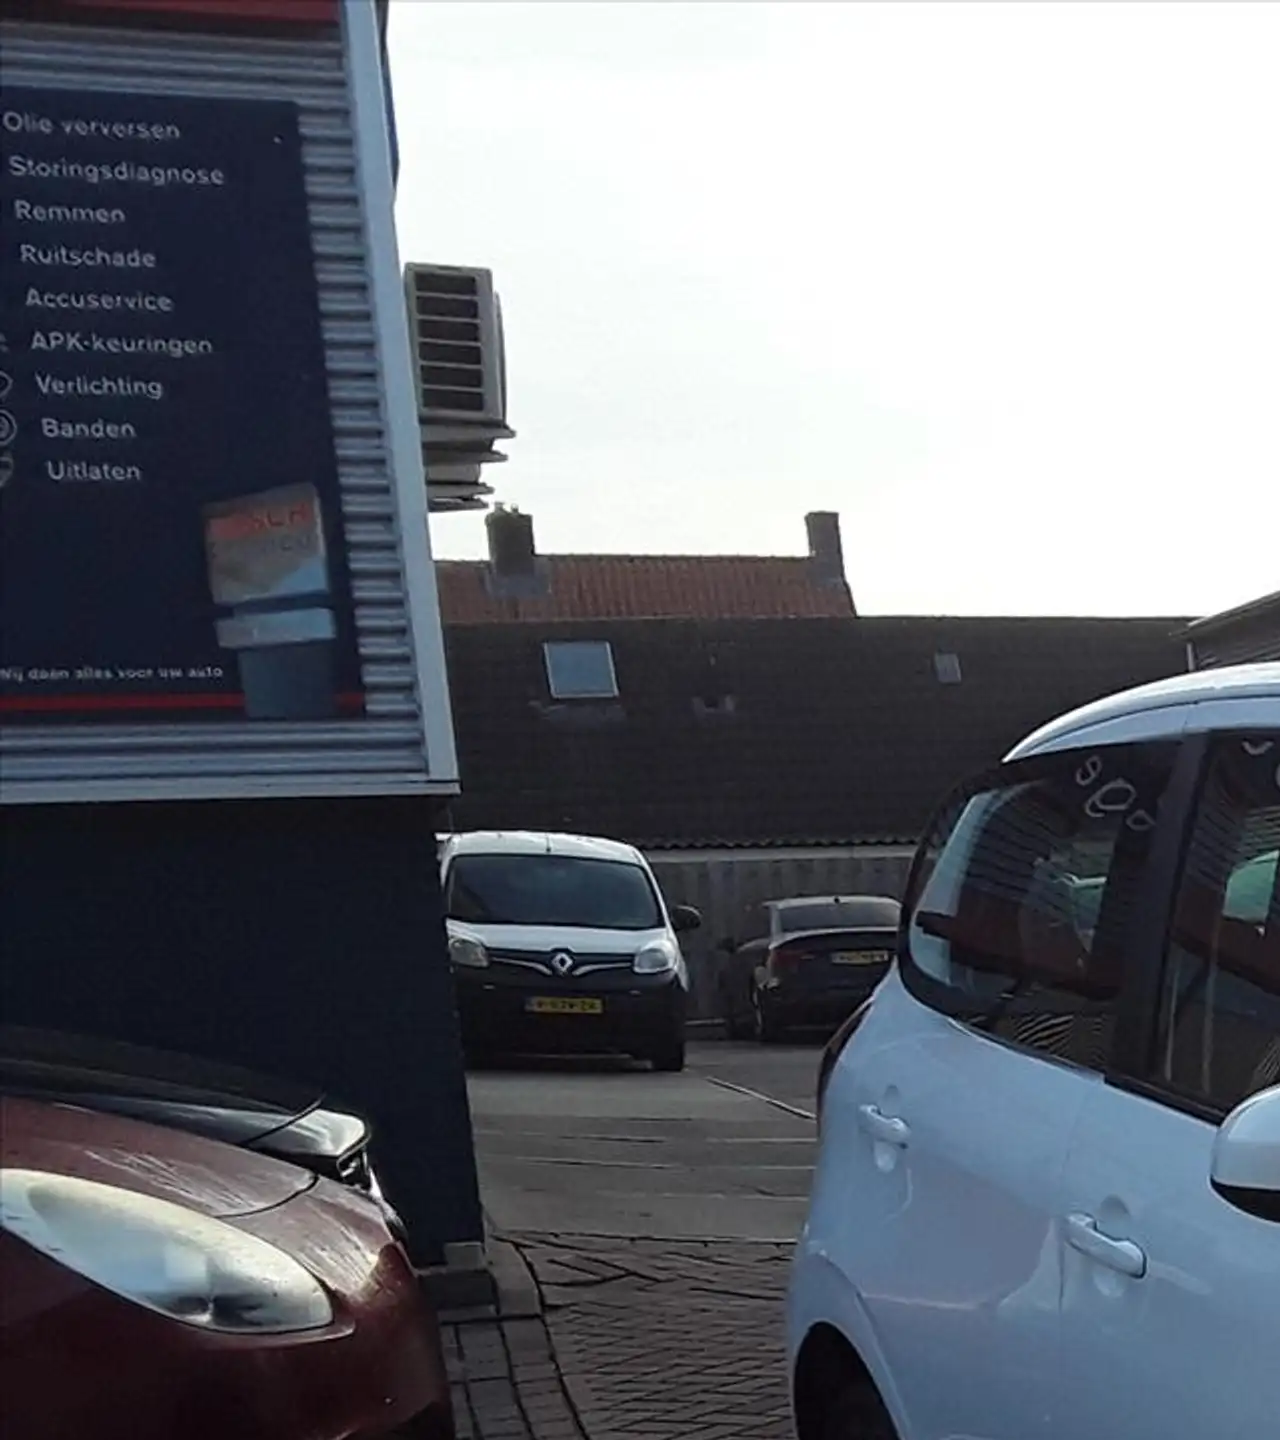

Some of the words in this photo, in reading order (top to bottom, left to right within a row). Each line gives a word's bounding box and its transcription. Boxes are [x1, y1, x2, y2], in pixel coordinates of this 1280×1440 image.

[3, 111, 53, 134] Olie
[61, 117, 180, 140] verversen
[8, 156, 225, 186] Storingsdiagnose
[14, 200, 126, 224] Remmen
[20, 244, 157, 268] Ruitschade
[25, 288, 173, 312] Accuservice
[31, 331, 213, 359] APK-keuringen
[35, 373, 163, 400] Verlichting
[41, 418, 136, 438] Banden
[46, 460, 142, 482] Uitlaten
